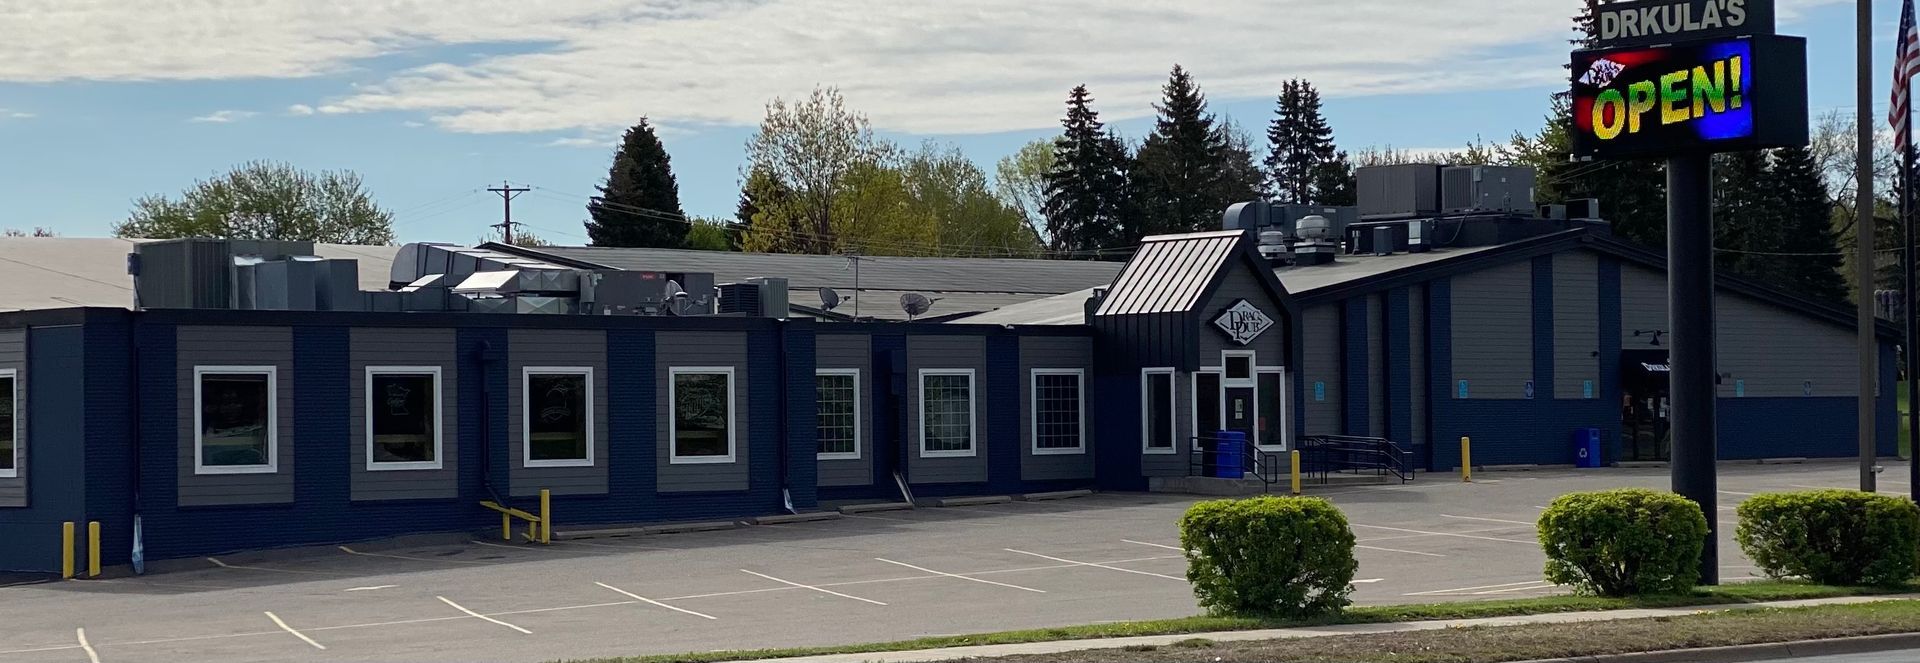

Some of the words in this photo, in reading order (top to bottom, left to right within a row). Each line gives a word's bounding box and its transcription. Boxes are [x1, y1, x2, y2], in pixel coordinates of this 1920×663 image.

[1601, 0, 1747, 40] DRKULA'S
[1592, 56, 1742, 140] OPEN!
[1235, 321, 1260, 340] PUB
